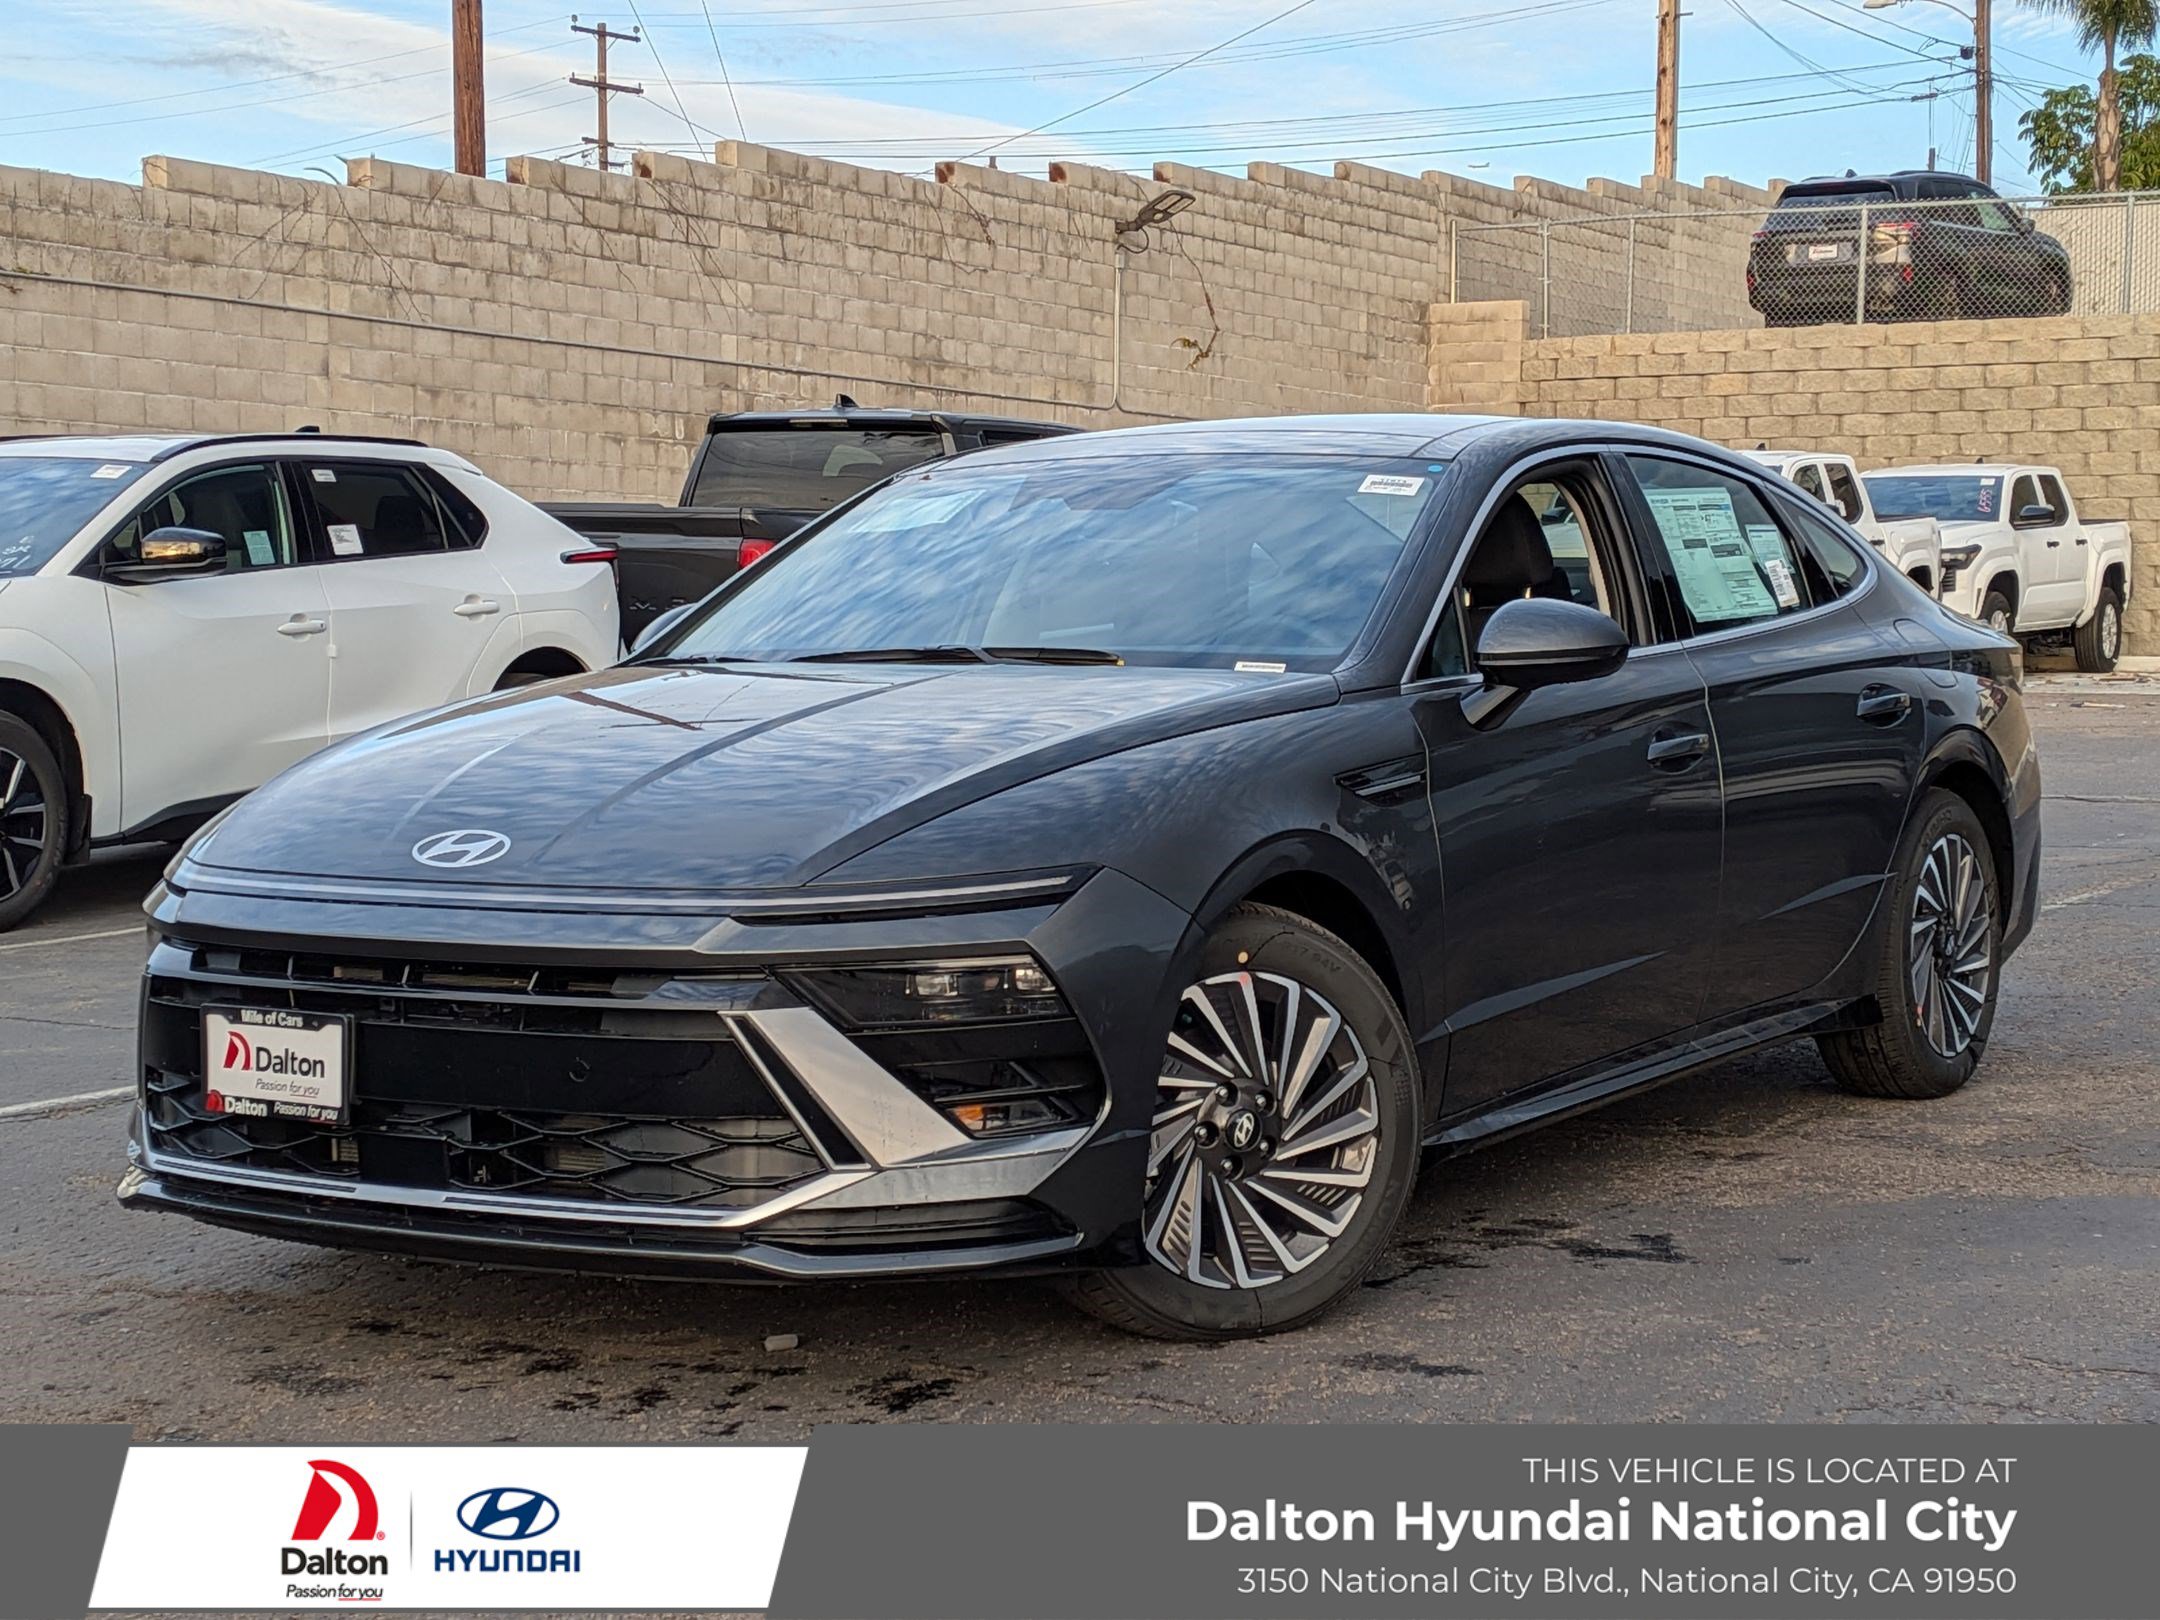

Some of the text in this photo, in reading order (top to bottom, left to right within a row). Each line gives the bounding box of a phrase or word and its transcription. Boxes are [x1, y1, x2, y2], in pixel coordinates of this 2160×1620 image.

[241, 1010, 304, 1028] Mile of Cars
[255, 1046, 325, 1078] Dalton
[255, 1078, 320, 1097] Passion for you
[224, 1097, 339, 1121] Dalton Passion for you
